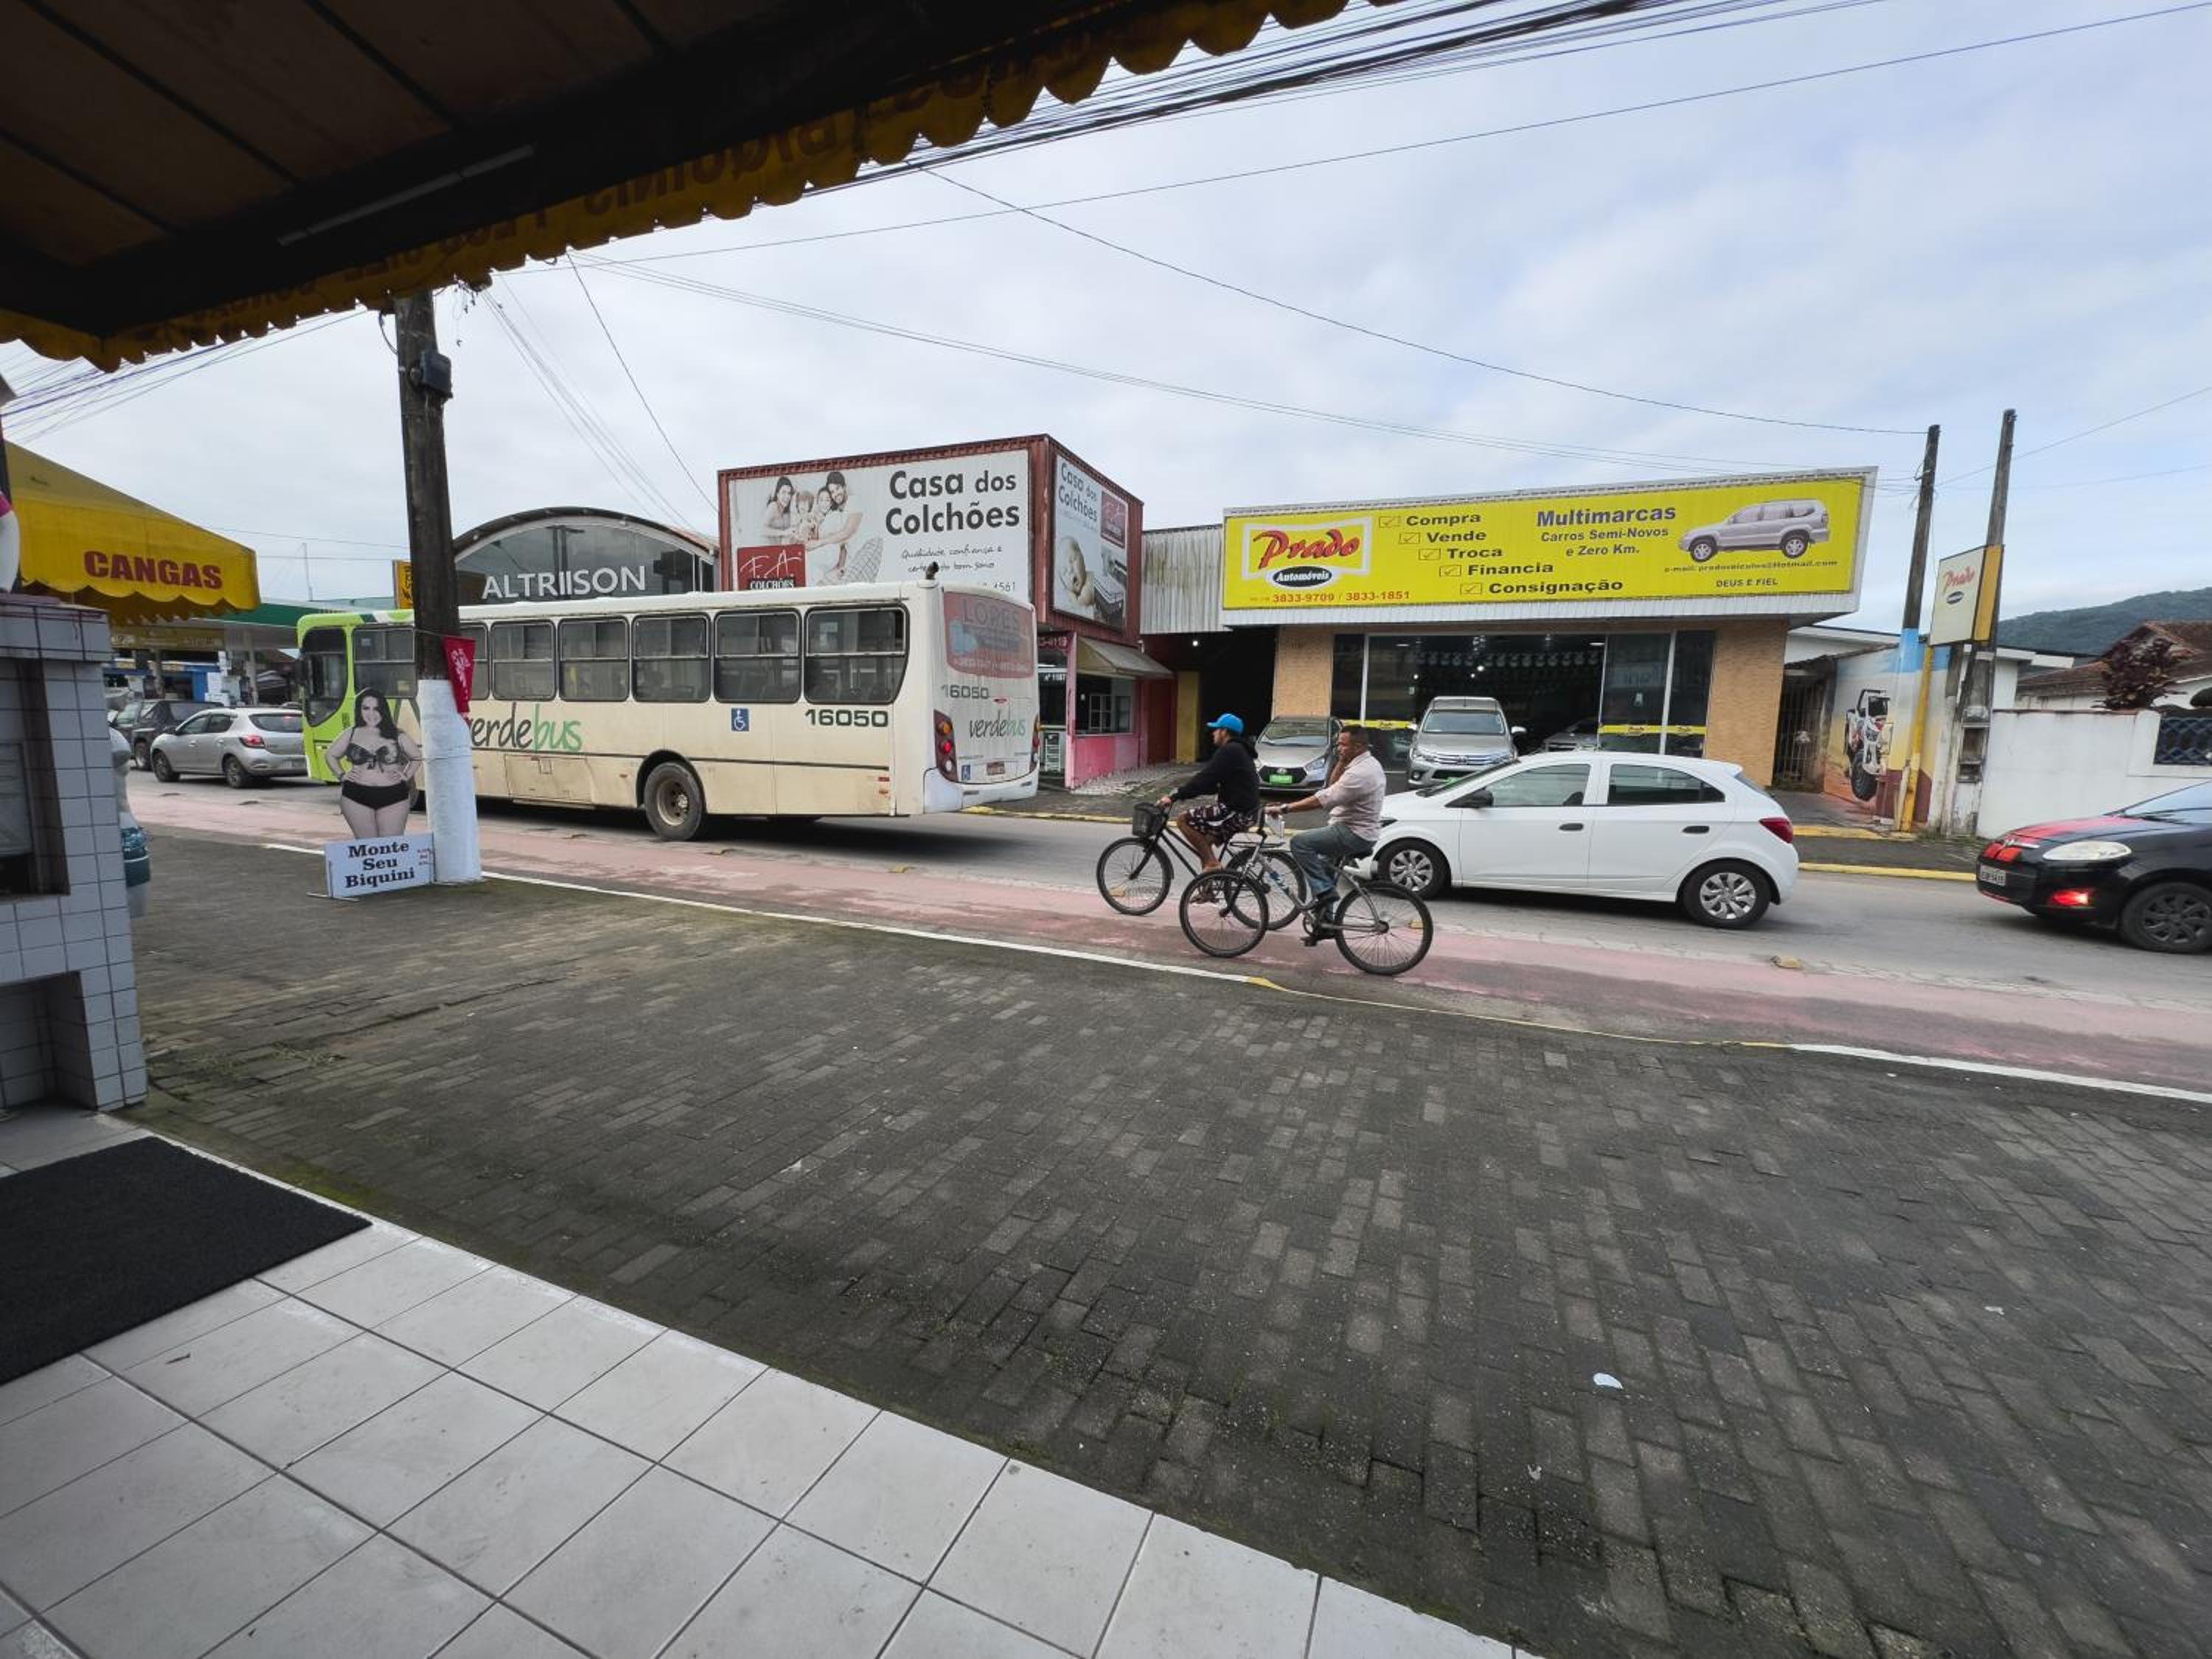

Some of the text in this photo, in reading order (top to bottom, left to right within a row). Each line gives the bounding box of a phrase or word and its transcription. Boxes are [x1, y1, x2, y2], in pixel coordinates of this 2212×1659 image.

[889, 469, 1017, 499] Casa dos
[1061, 462, 1085, 491] Casa
[1059, 485, 1098, 522] Colchões
[886, 501, 1020, 535] Colchões
[1406, 512, 1482, 528] Compra
[1537, 507, 1676, 526] Multimarcas
[1427, 530, 1486, 543] Vende
[1541, 527, 1669, 542] Carros Semi-Novos
[1253, 529, 1360, 570] Prado
[1447, 547, 1503, 560] Troca
[1566, 543, 1639, 557] e Zero Km.
[83, 550, 223, 590] CANGAS
[1275, 569, 1331, 585] Automóveis
[1467, 562, 1554, 577] Financia
[1489, 578, 1624, 594] Consignação
[1716, 579, 1743, 588] DEUS
[1756, 578, 1778, 587] FIEL
[1942, 566, 1977, 594] Prado
[941, 684, 990, 700] 16050
[804, 709, 889, 728] 16050
[347, 841, 410, 858] Monte
[362, 857, 398, 872] Seu
[344, 867, 416, 888] Biquini
